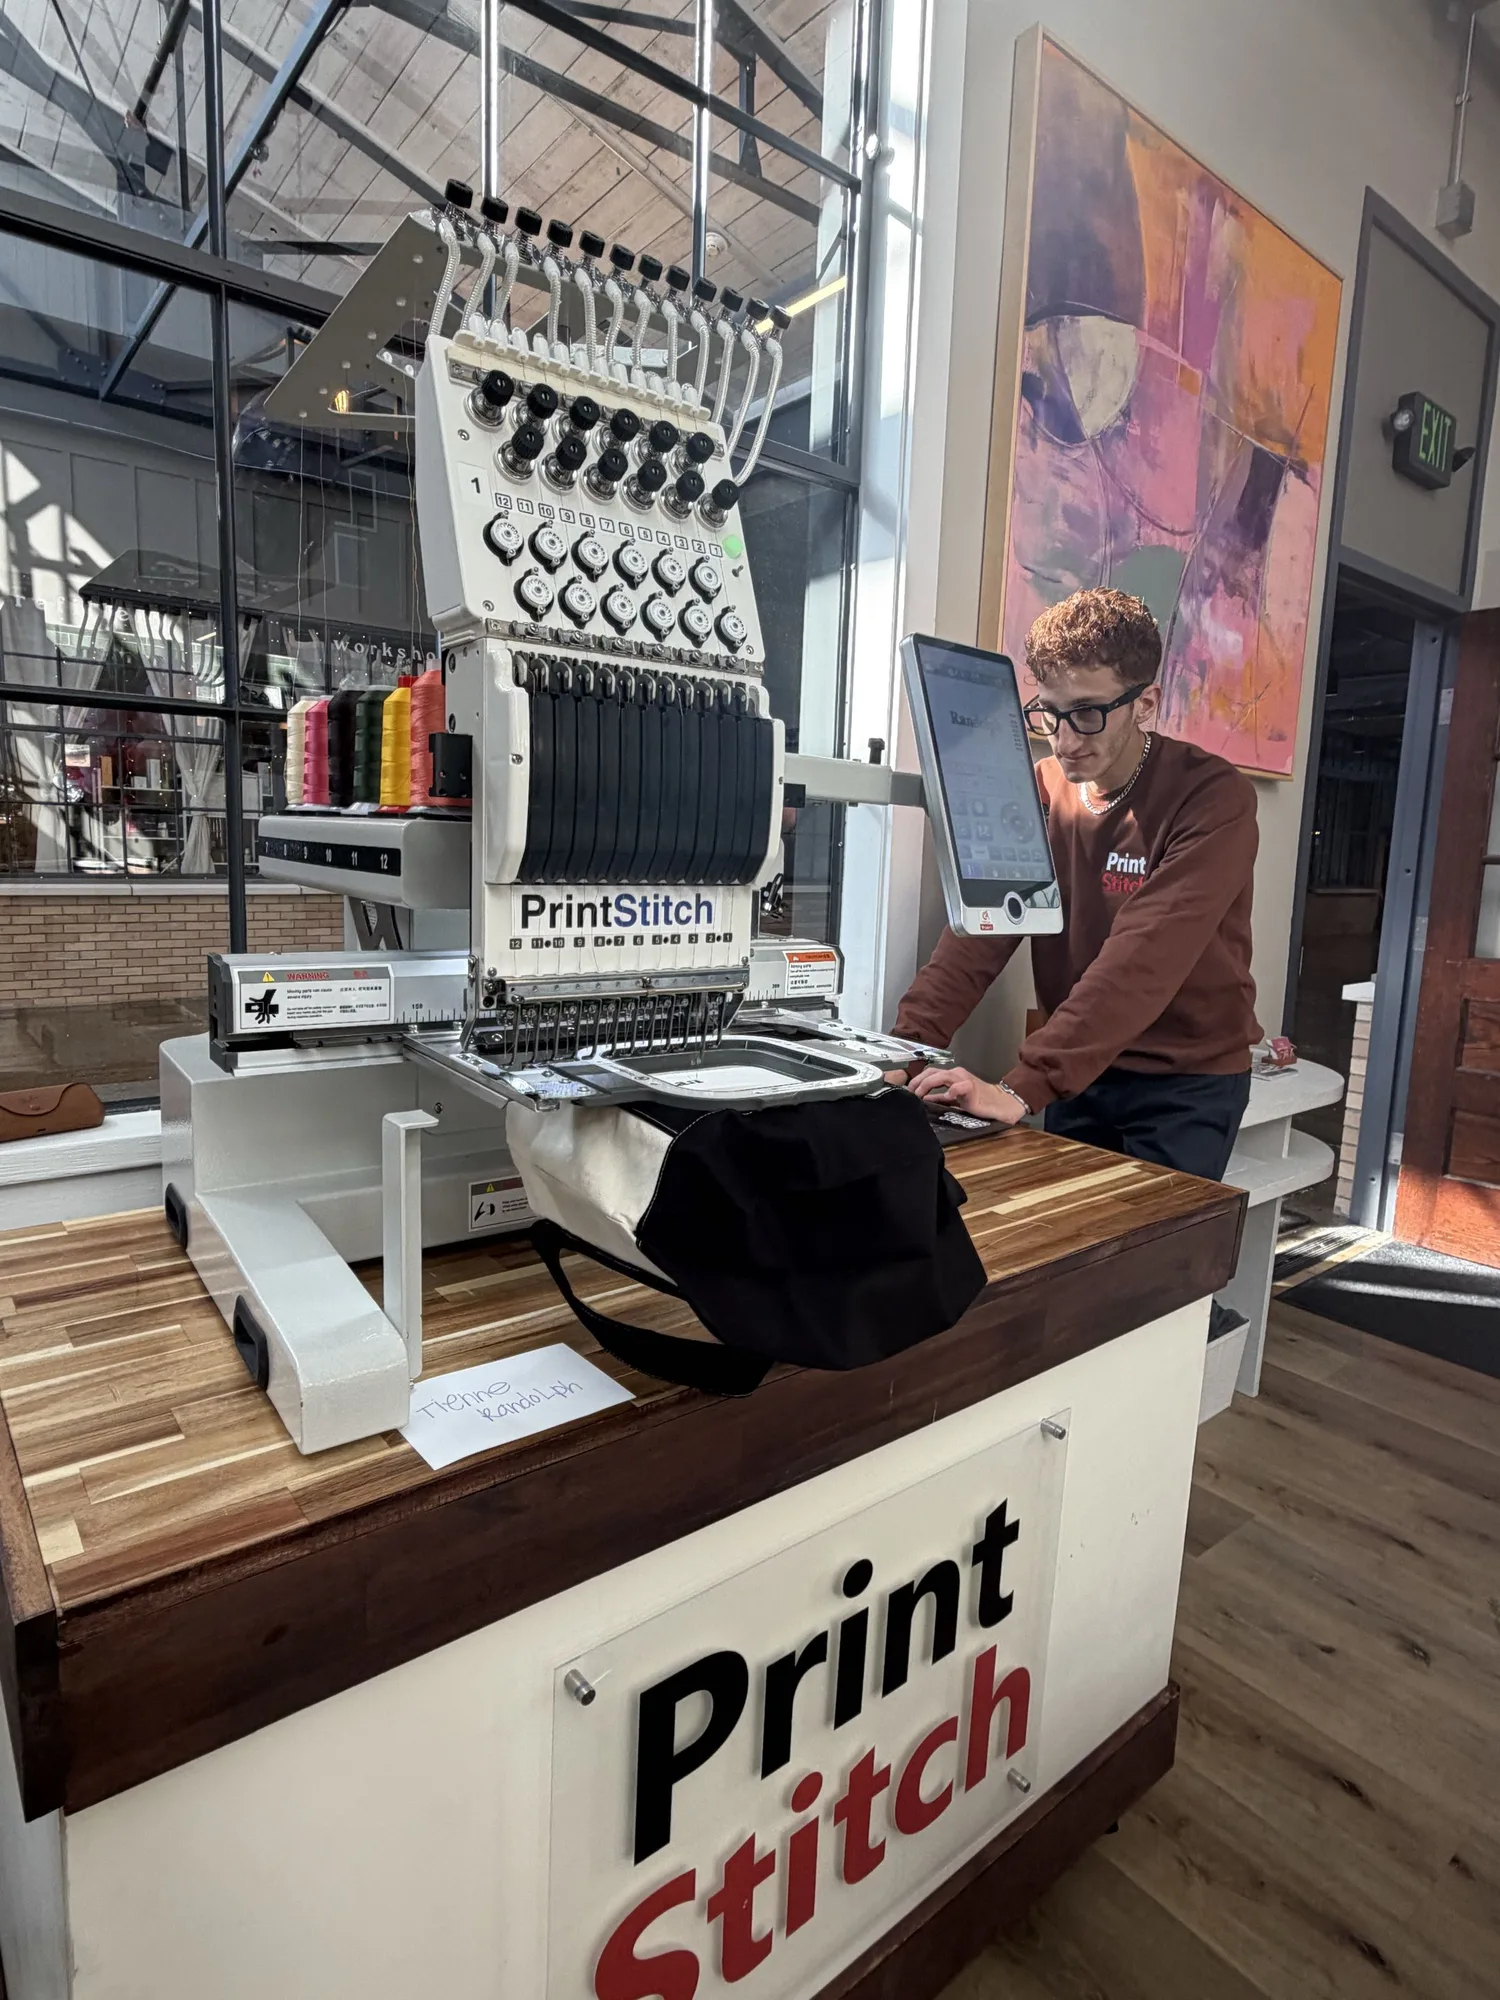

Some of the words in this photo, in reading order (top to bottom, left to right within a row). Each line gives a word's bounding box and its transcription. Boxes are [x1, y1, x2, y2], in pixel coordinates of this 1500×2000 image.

[1419, 401, 1452, 472] EXIT
[470, 477, 480, 494] 1
[326, 848, 332, 863] 10
[351, 851, 358, 867] 11
[380, 853, 389, 870] 12
[1105, 852, 1146, 875] Print
[521, 893, 713, 929] PrintStitch
[286, 971, 329, 981] WARNING
[633, 1497, 1020, 1867] Print
[594, 1643, 1031, 2000] Stitch
